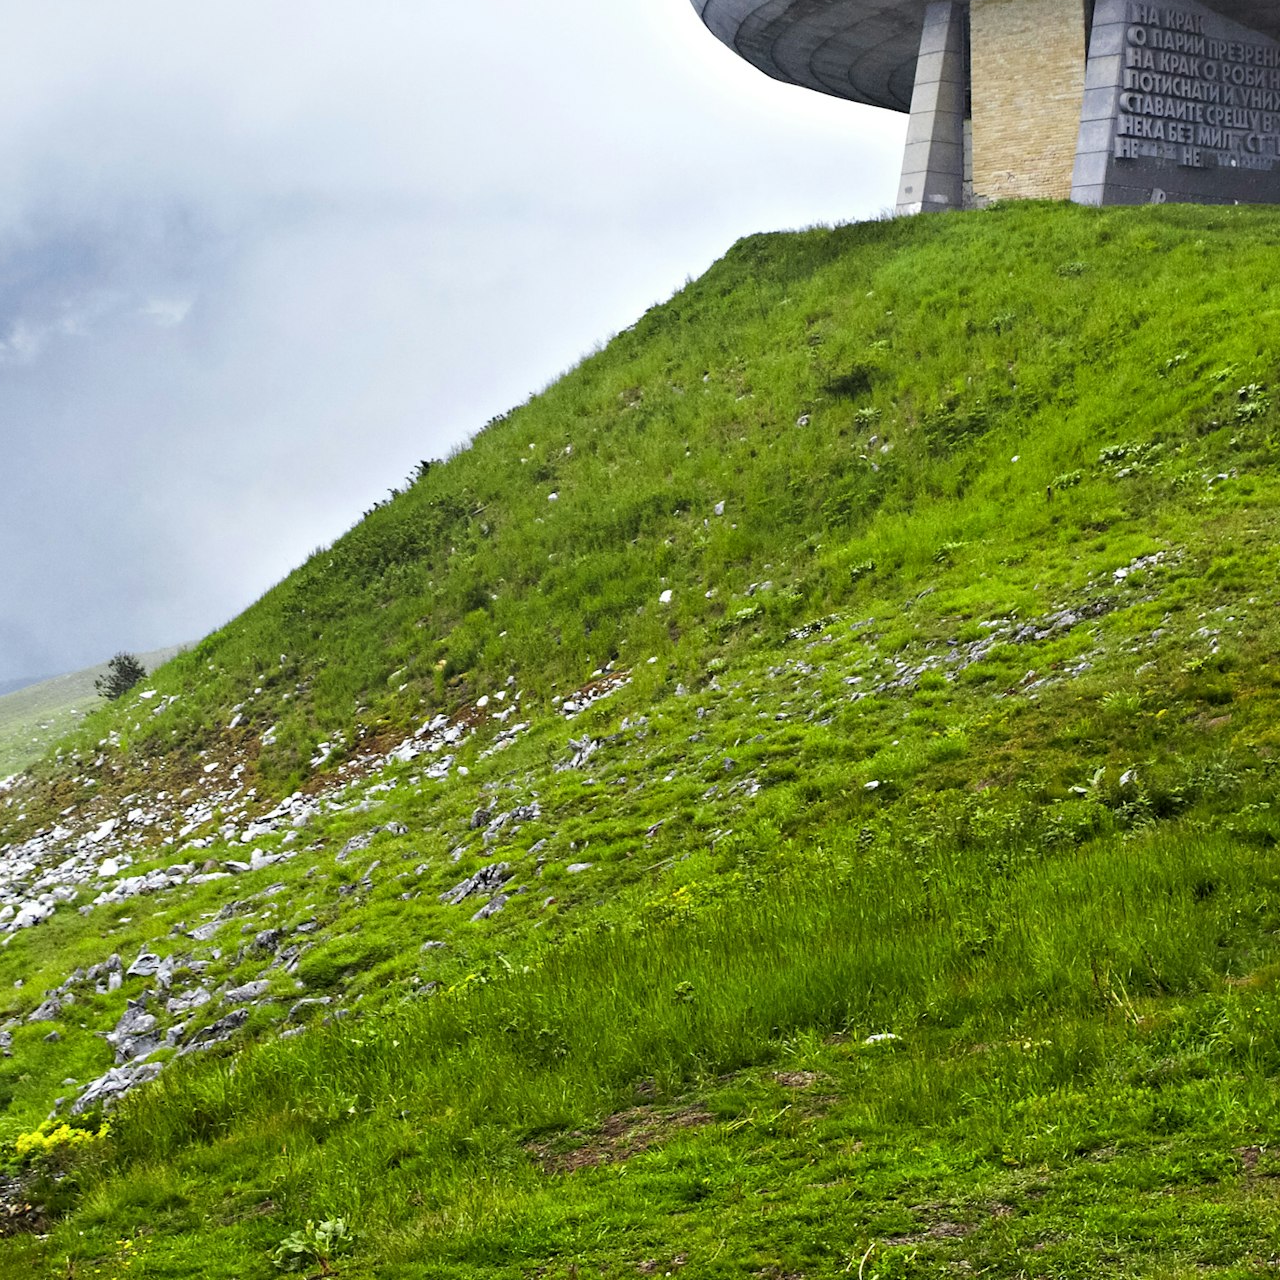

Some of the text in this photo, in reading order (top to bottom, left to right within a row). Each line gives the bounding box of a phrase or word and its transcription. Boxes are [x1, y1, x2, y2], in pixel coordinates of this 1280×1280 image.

[1131, 4, 1205, 35] НА КРАК
[1126, 25, 1147, 47] О
[1125, 47, 1156, 70] НА
[1160, 52, 1201, 78] КРАК
[1203, 60, 1217, 81] О
[1222, 63, 1266, 89] РОБИ
[1123, 68, 1221, 105] ПОТИСНАТИ
[1223, 85, 1236, 108] И
[1117, 113, 1165, 141] НЕКА
[1168, 121, 1195, 145] БЕЗ
